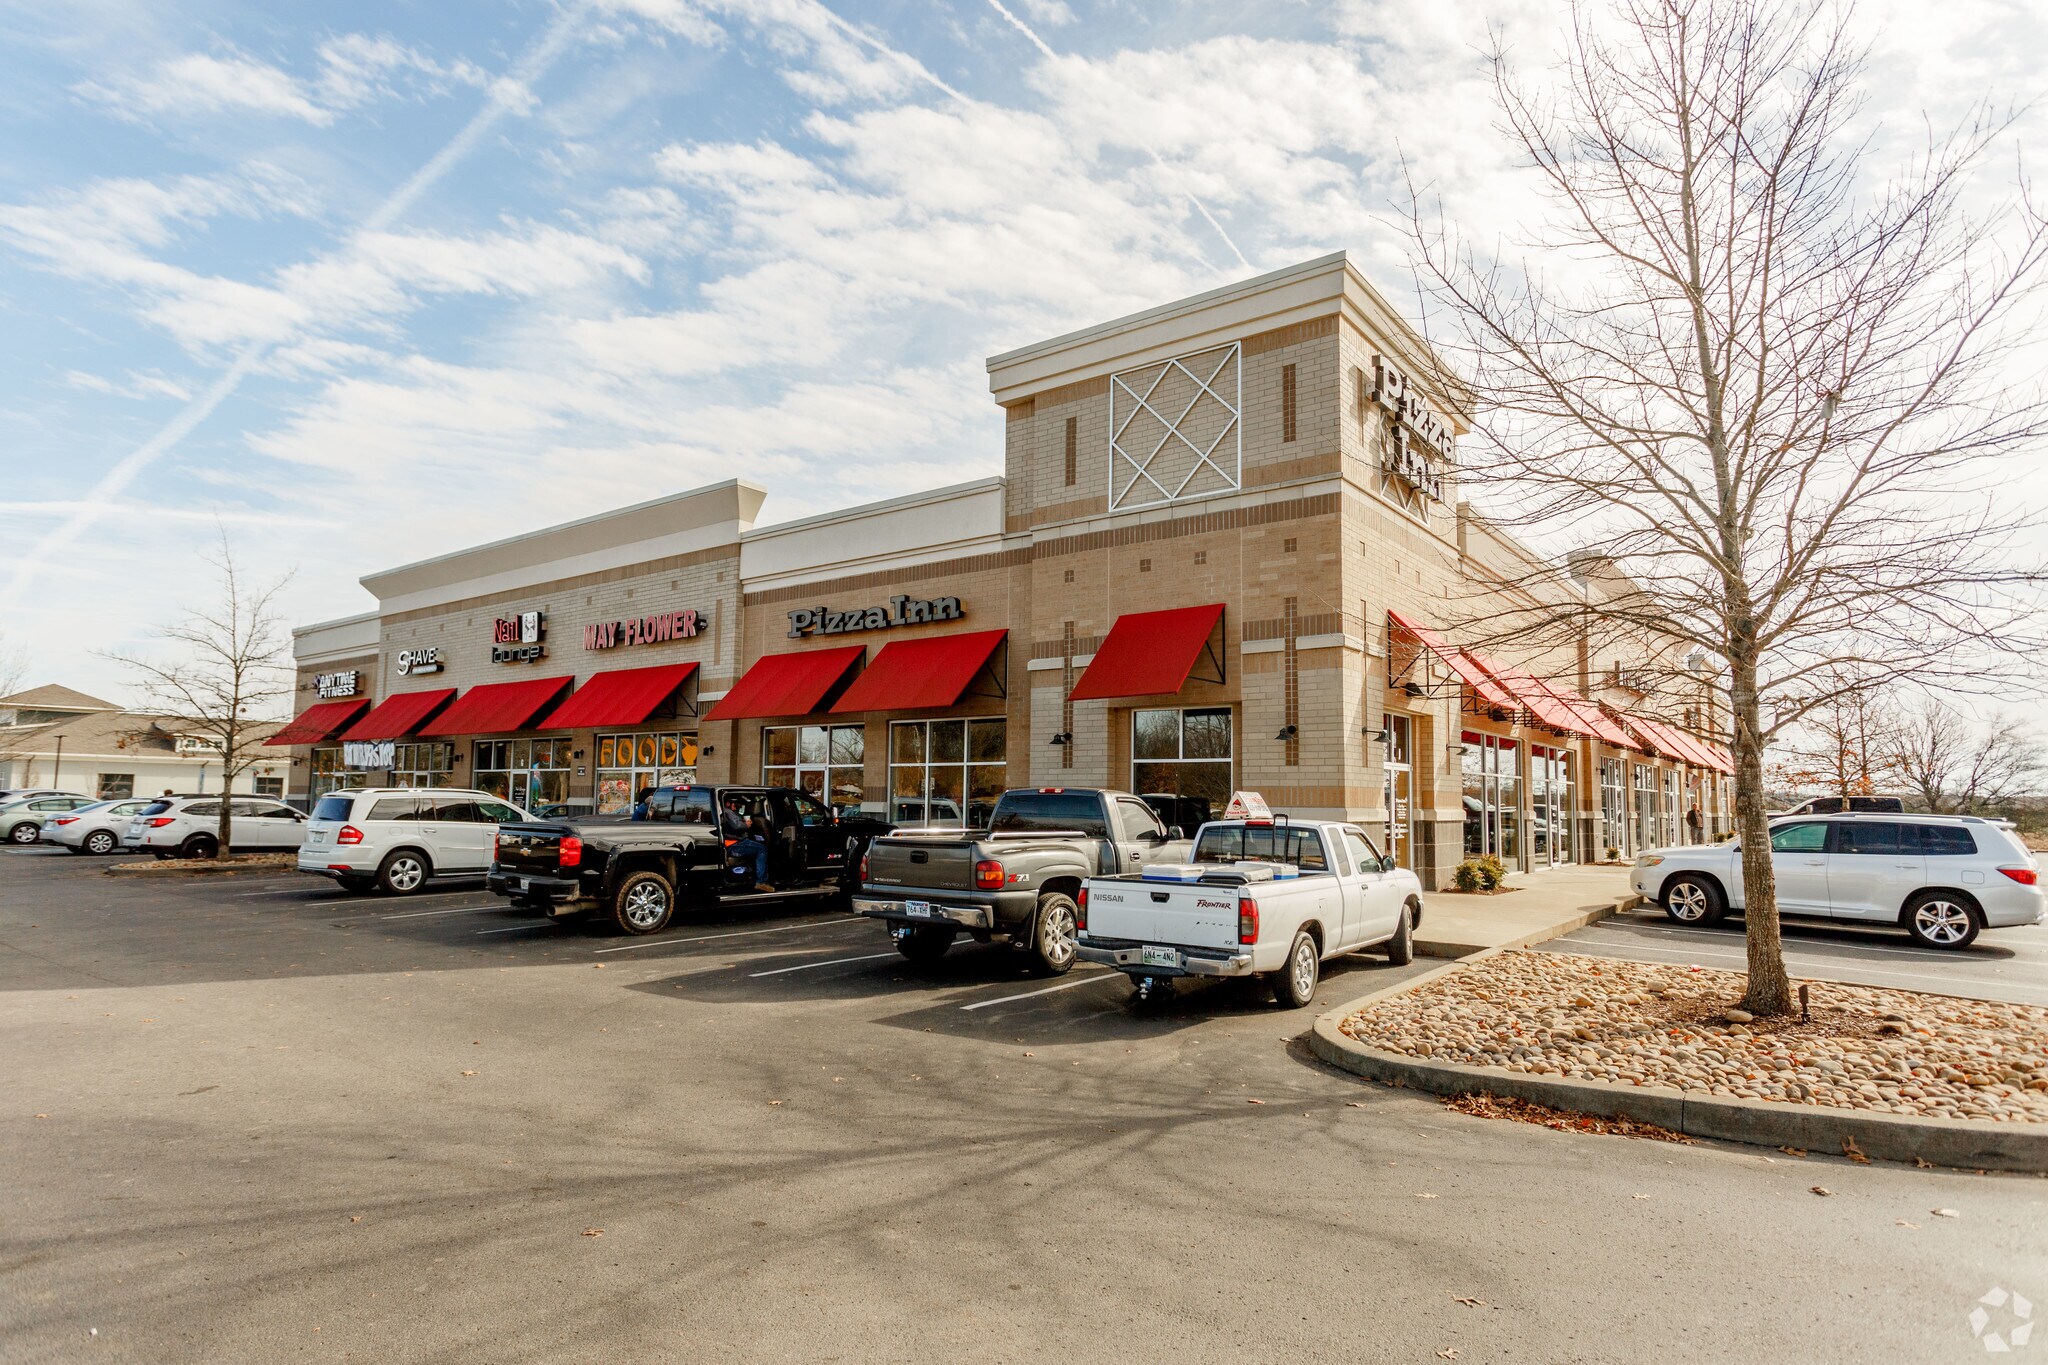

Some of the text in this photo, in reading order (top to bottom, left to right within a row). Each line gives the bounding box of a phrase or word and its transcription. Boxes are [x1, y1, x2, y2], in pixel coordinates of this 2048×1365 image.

[1373, 353, 1454, 462] Pizza
[1389, 427, 1441, 500] Inn
[493, 614, 519, 643] Nail
[583, 610, 697, 650] MAY FLOWER
[788, 595, 961, 638] Pizza Inn
[397, 647, 437, 676] SHAVE
[319, 670, 356, 688] ANYTIME
[319, 684, 355, 699] FITNESS
[600, 737, 678, 766] FOOD
[1007, 873, 1030, 883] Z71
[1094, 893, 1124, 903] NISSAN
